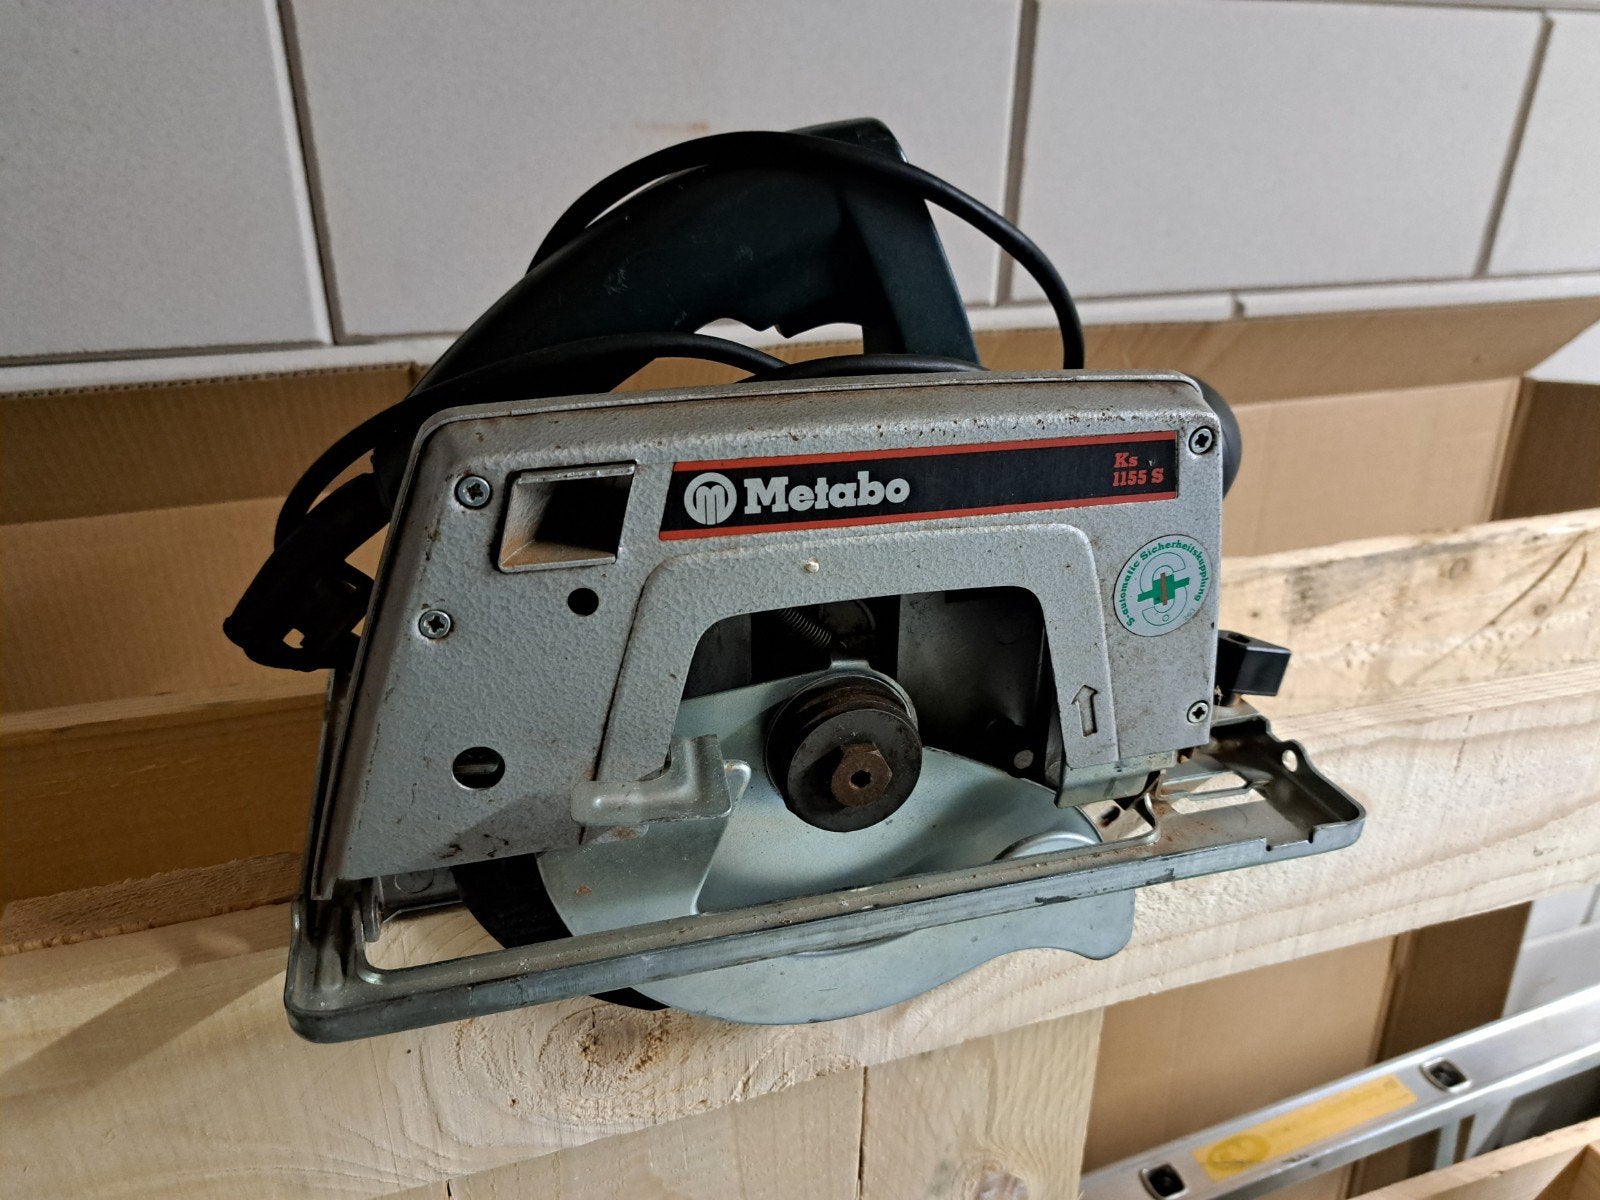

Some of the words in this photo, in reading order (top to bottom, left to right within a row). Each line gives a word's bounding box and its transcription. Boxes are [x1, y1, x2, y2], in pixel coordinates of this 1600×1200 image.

[1113, 452, 1139, 468] Ks
[743, 470, 911, 515] Metabo
[1111, 470, 1147, 487] 1155
[1150, 467, 1164, 484] S
[1139, 539, 1209, 602] Sicherheitskupplung
